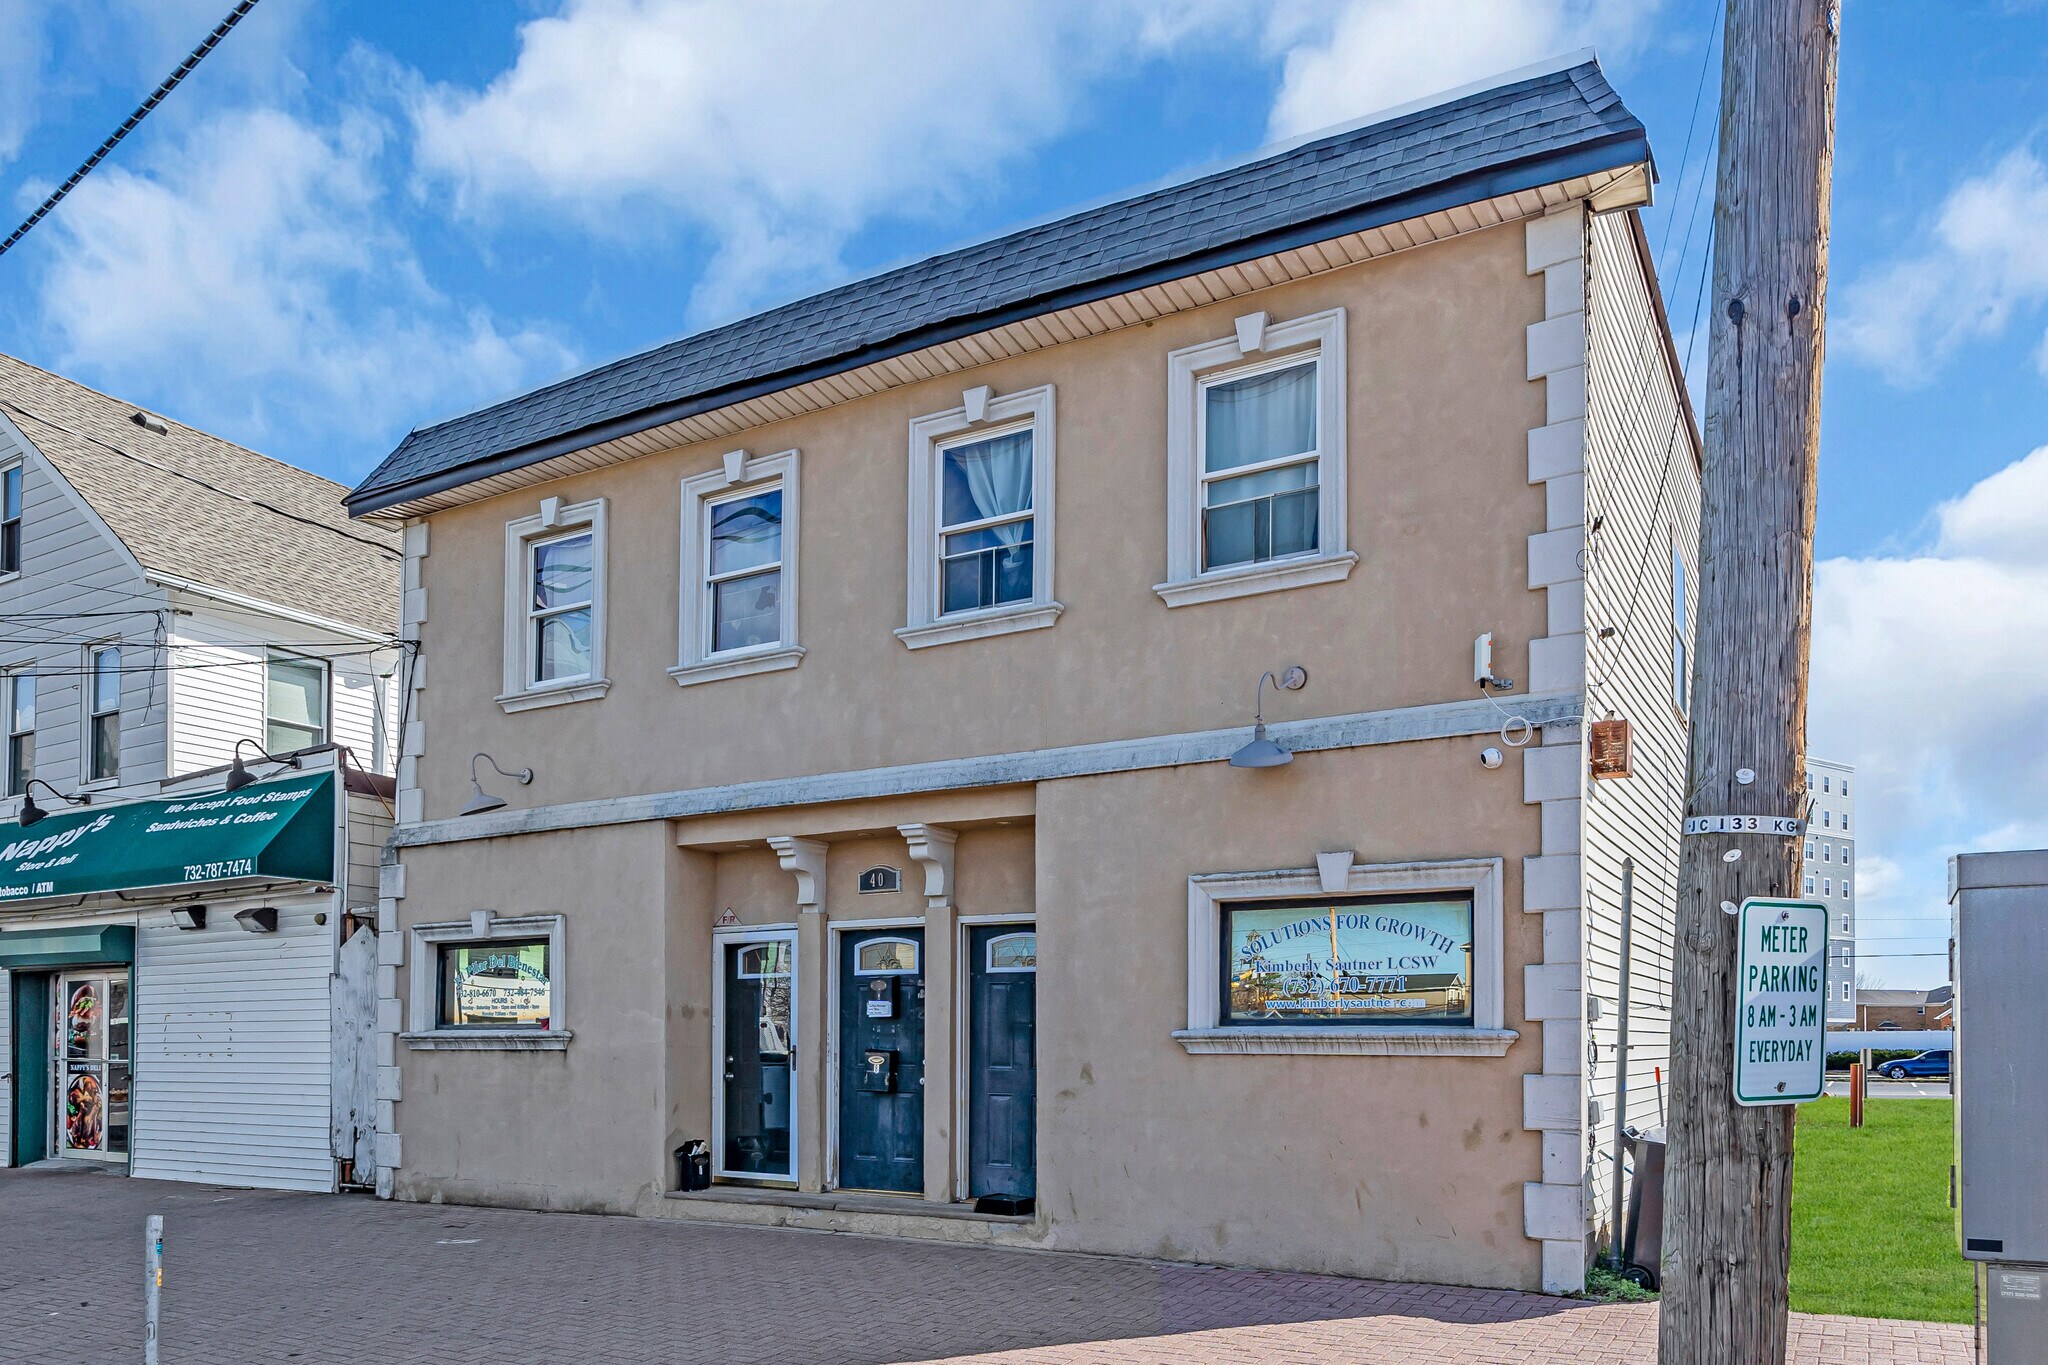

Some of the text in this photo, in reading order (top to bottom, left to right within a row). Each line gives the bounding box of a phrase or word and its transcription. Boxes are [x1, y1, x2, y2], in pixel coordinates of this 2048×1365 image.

[164, 788, 313, 814] We Accept Food Stamps
[145, 811, 278, 833] Sandwiches & Coffee
[1719, 817, 1758, 830] 133
[1774, 820, 1797, 833] KG
[0, 814, 115, 861] Nappy's
[15, 862, 45, 872] Store
[53, 853, 79, 867] Deli
[184, 858, 251, 881] 732-787-7474
[36, 881, 54, 894] ATM
[869, 872, 884, 888] 40
[1240, 914, 1455, 962] SOLUTIONS FOR GROWTH
[1761, 925, 1808, 953] METER
[488, 955, 506, 969] Del
[508, 955, 550, 986] Bienestar
[1255, 954, 1439, 975] Kimberly Sautner LCSW
[1282, 974, 1408, 999] (732) 670-7771
[1748, 965, 1818, 993] PARKING
[1265, 998, 1426, 1010] www.kimberlysautnec
[1747, 1005, 1755, 1027] 8
[1758, 1005, 1777, 1027] AM
[1788, 1005, 1796, 1027] 3
[1799, 1005, 1817, 1027] AM
[1749, 1039, 1813, 1063] EVERYDAY
